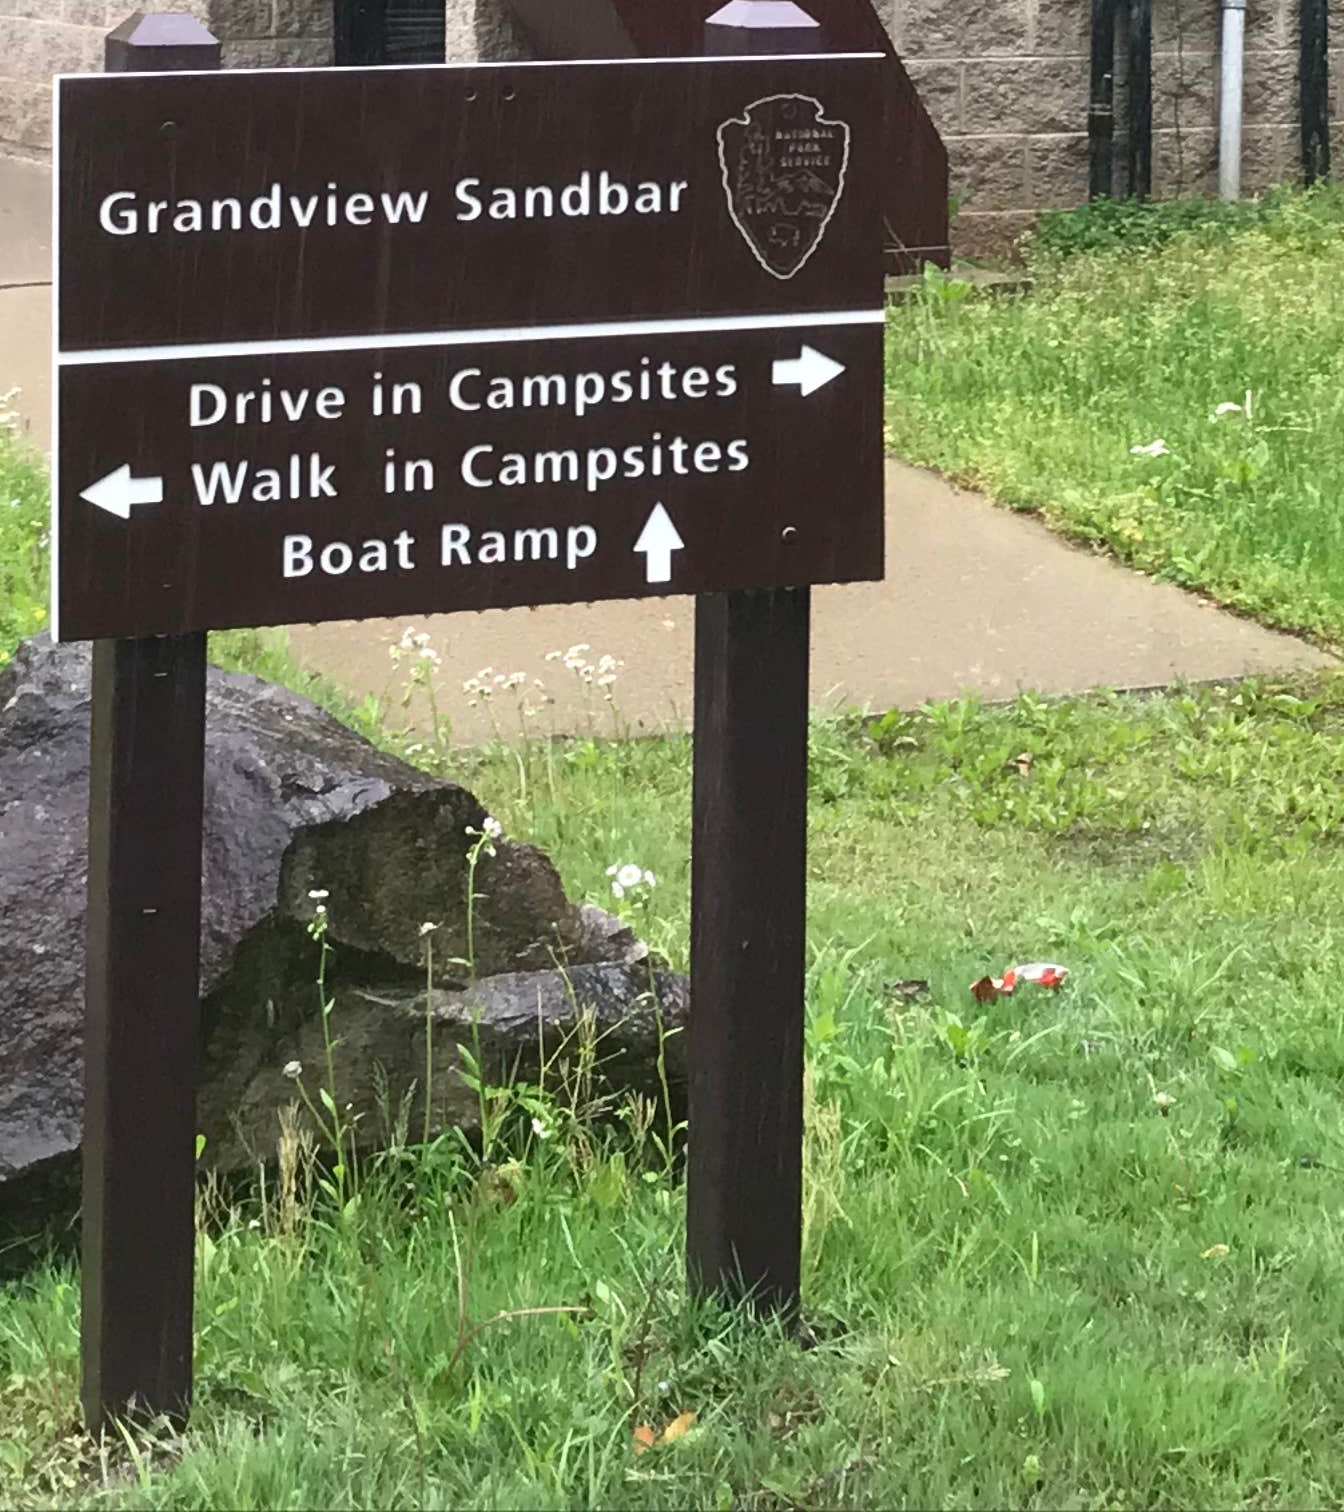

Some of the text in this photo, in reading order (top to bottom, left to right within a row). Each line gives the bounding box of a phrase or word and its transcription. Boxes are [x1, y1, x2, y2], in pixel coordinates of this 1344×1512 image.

[99, 170, 688, 236] Grandview Sandbar
[189, 356, 737, 427] Drive in Campsites
[191, 432, 749, 506] Walk in Campsites
[283, 523, 597, 578] Boat Ramp
